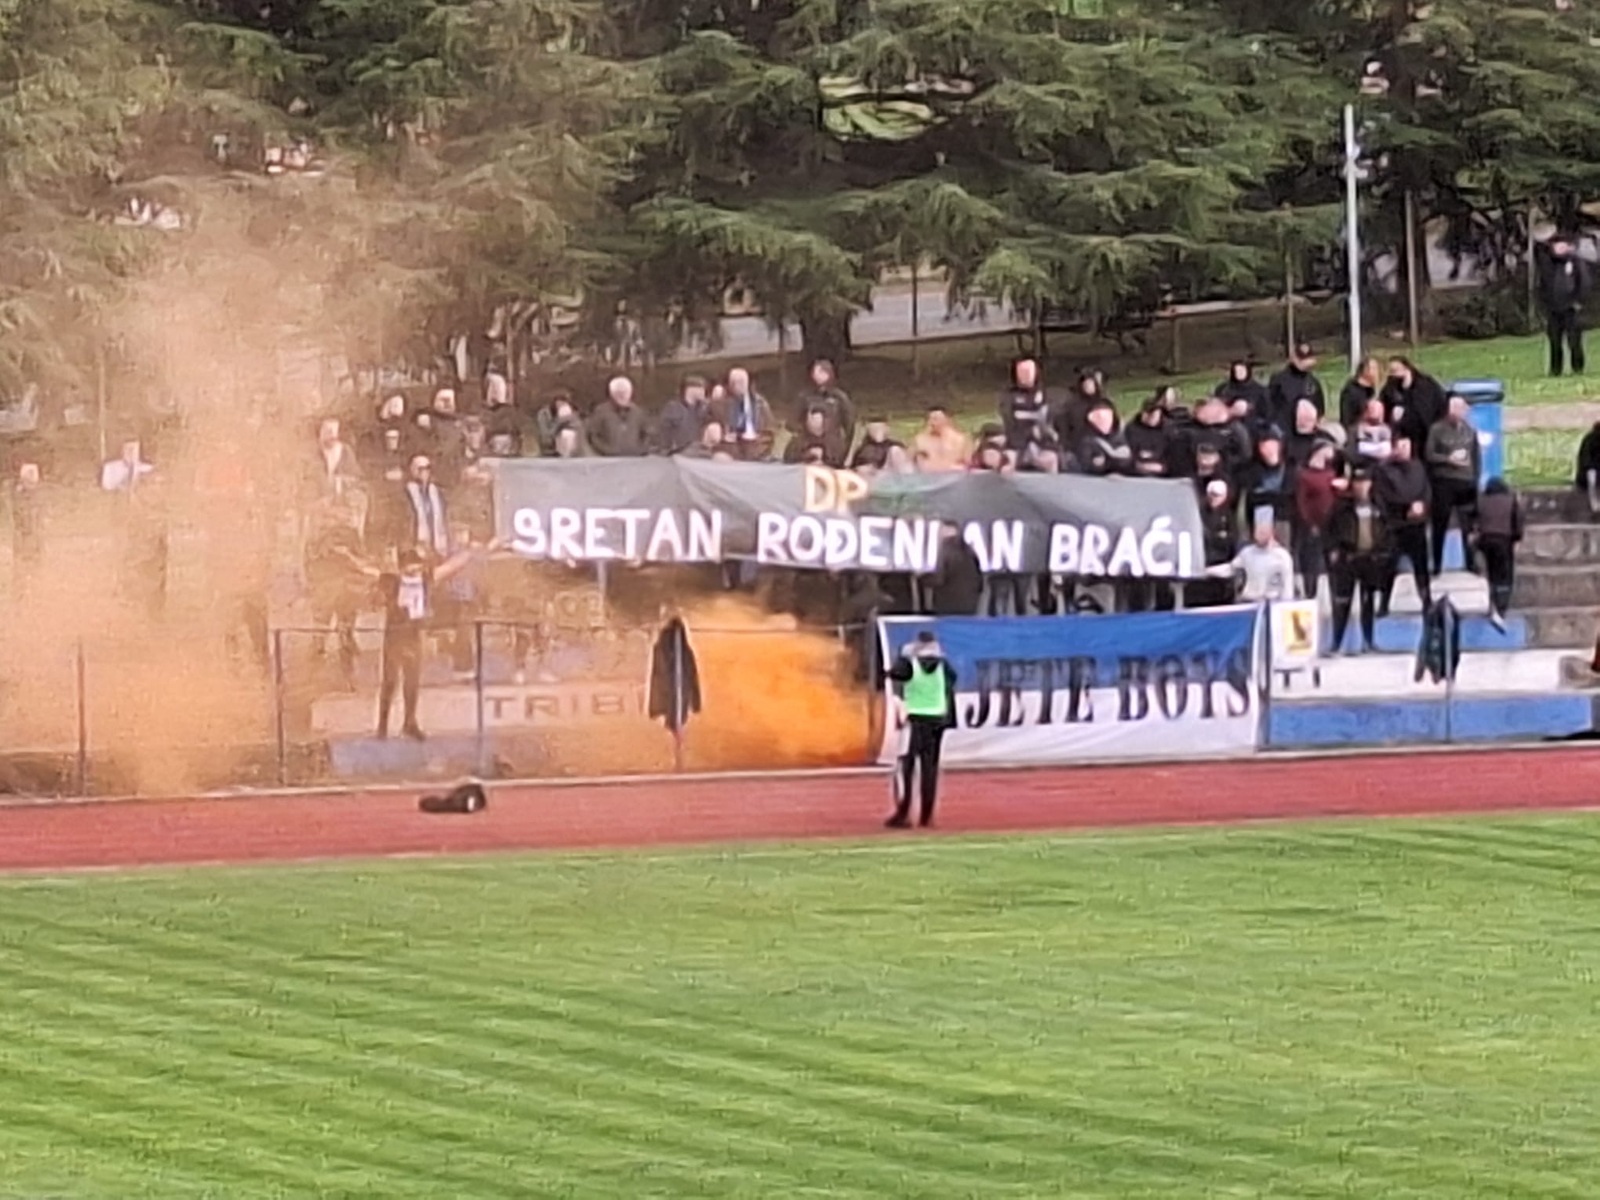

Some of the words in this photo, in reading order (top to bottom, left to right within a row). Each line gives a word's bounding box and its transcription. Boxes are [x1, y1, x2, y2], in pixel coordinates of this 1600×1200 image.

[804, 465, 868, 514] DP
[511, 507, 722, 560] SRETAN
[1049, 514, 1192, 578] BRAĆI
[484, 694, 649, 719] TRIB
[1116, 647, 1252, 722] BOYS
